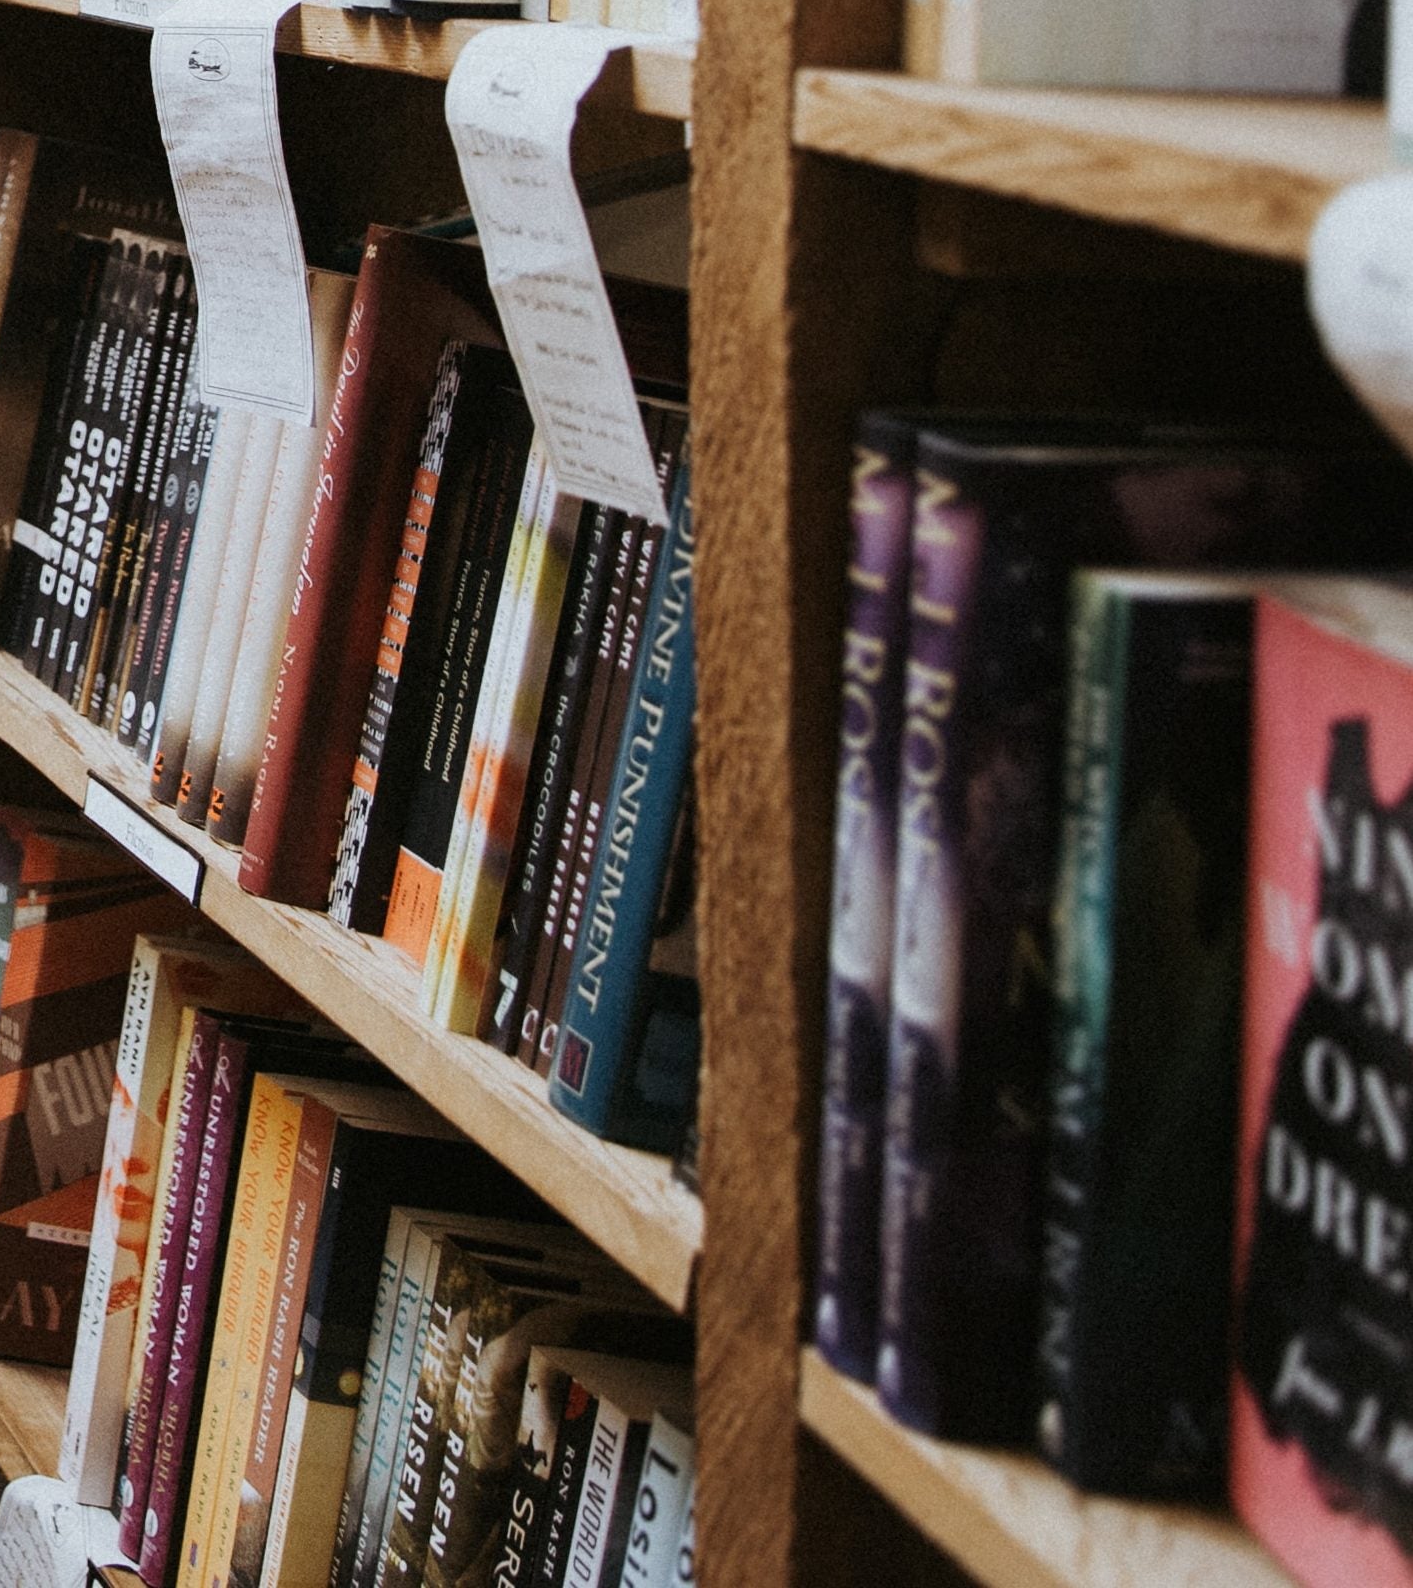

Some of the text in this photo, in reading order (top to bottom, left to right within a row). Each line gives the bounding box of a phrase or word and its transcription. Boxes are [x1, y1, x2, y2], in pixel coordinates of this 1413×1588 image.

[133, 344, 172, 494] IMPERFECTIONISTS
[147, 350, 187, 502] IMPERFECTIONISTS
[290, 300, 365, 617] The Devil in Jerusalem
[38, 419, 87, 596] OTARED
[56, 427, 105, 607] OTARED
[73, 437, 123, 620] OTARED
[133, 519, 170, 666] Tom Rachman
[153, 526, 191, 676] Tom Rachman
[423, 559, 472, 772] France, Story of Childhood
[573, 551, 598, 635] RAKHA
[598, 529, 633, 660] WHY I CAME
[617, 539, 654, 671] WHY I CAME
[251, 643, 297, 814] NAOMI RAGEN
[440, 568, 491, 784] France, Story of Childhood
[521, 694, 570, 893] the CROCODILES
[544, 789, 580, 938] MARY RAKOW
[575, 696, 665, 1016] PUNISHMENT
[563, 800, 601, 952] MARY RAKOW
[129, 958, 142, 996] AYN
[130, 970, 151, 1076] AYN RAND
[144, 1072, 197, 1360] UNRESTORED WOMAN
[167, 1095, 223, 1387] UNRESTORED WOMAN
[223, 1093, 273, 1335] KNOW YOUR BEHOLDER
[246, 1119, 298, 1367] KNOW YOUR BEHOLDER
[252, 1199, 307, 1466] The RON RASH READER
[373, 1254, 399, 1336] Ron
[129, 1374, 154, 1467] SHOBHA
[155, 1401, 180, 1495] SHOBHA
[197, 1403, 219, 1460] ADAM
[372, 1274, 421, 1480] Ron Rash
[396, 1301, 452, 1524] THE RISEN
[428, 1331, 483, 1559] THE RISEN
[226, 1435, 243, 1493] ADAM
[336, 1490, 351, 1549] ABOVE
[543, 1444, 576, 1580] RON RASH
[572, 1422, 619, 1583] THE WORLD
[353, 1510, 370, 1573] ABOVE
